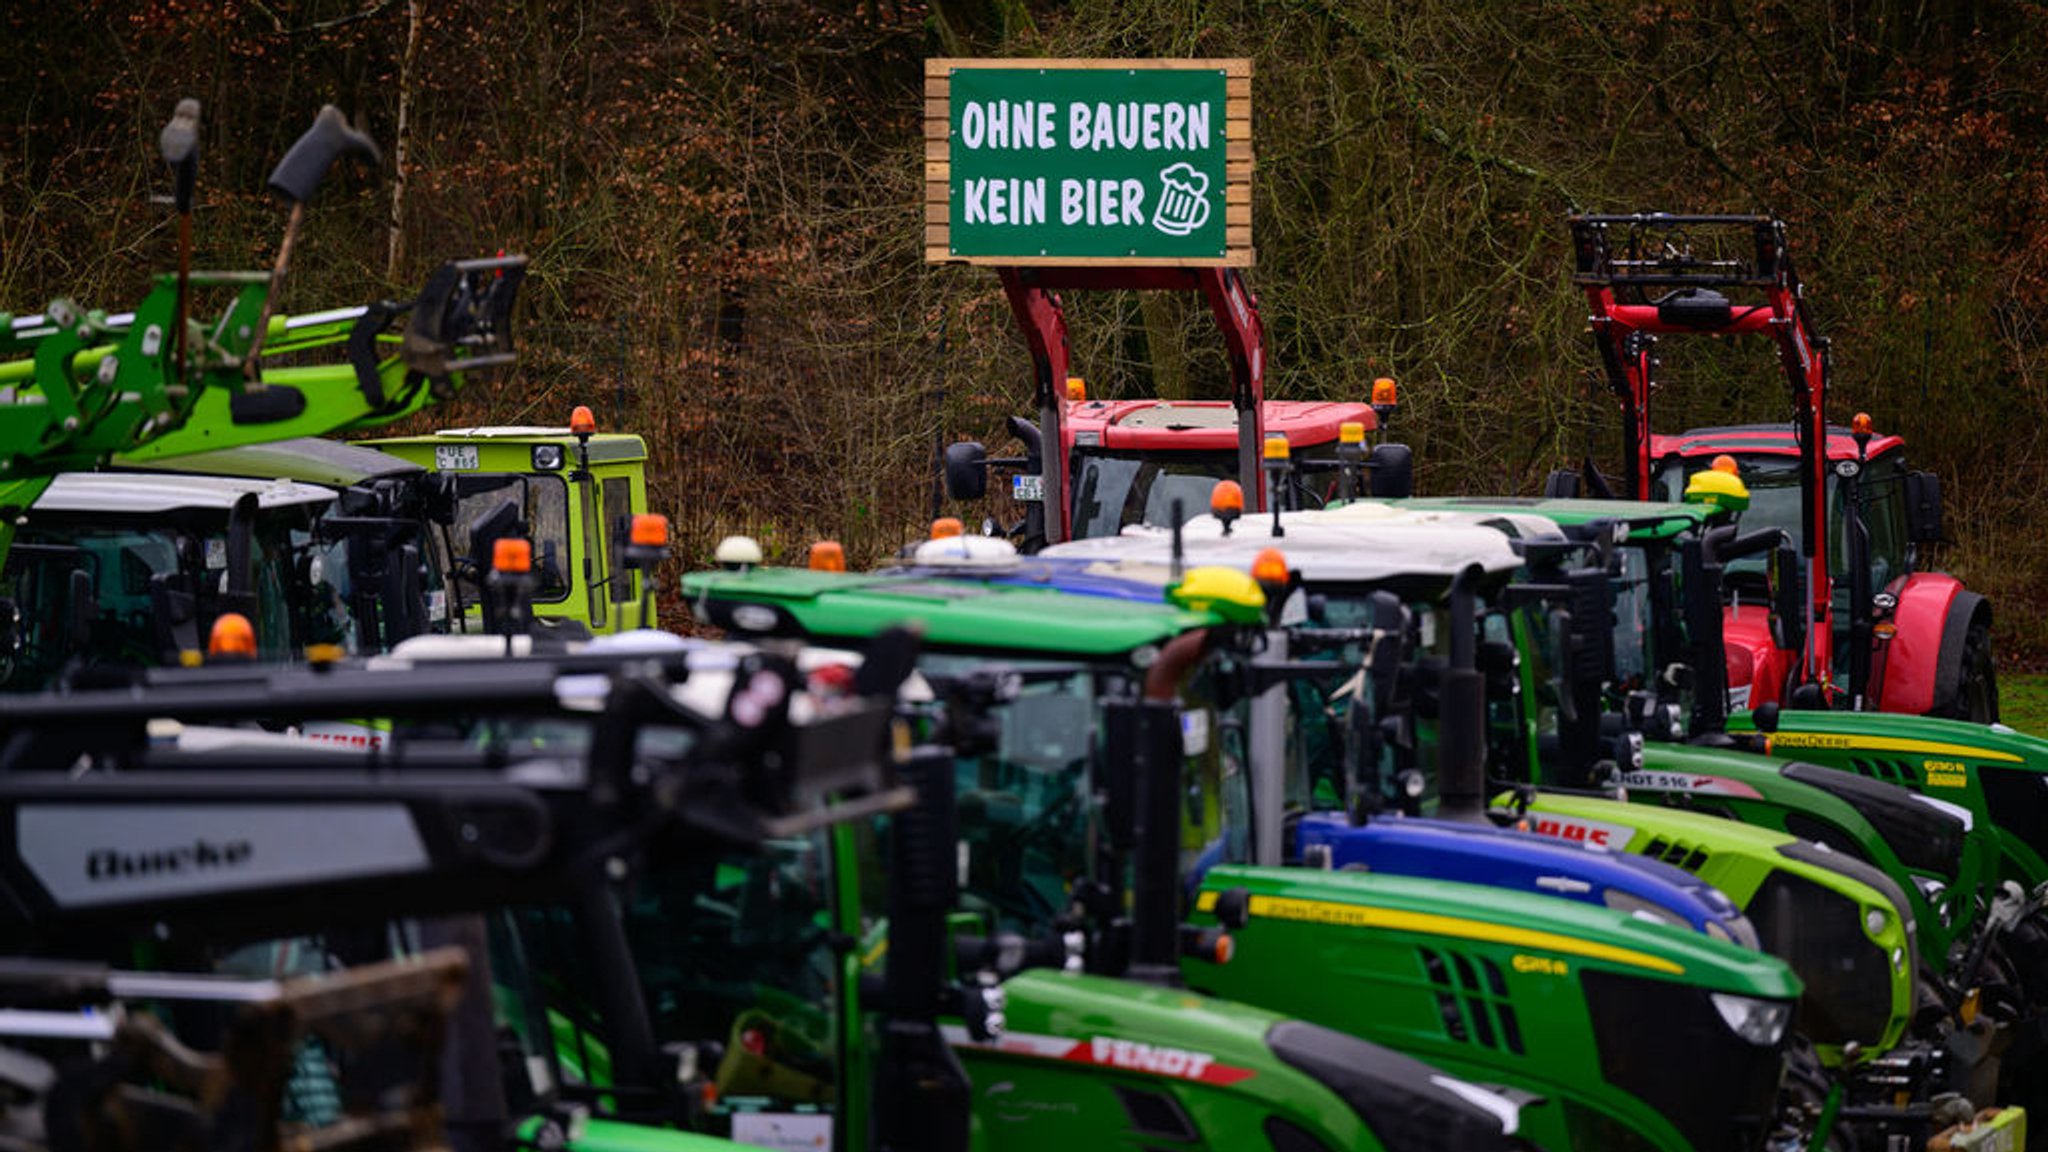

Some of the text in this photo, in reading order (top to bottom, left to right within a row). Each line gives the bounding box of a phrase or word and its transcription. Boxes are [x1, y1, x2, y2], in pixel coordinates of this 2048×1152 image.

[962, 100, 1210, 150] OHNE BAUERN
[964, 177, 1145, 225] KEIN BIER
[448, 445, 464, 457] UE
[1774, 731, 1850, 749] JOHN DEERE
[1091, 1035, 1215, 1080] FENDT
